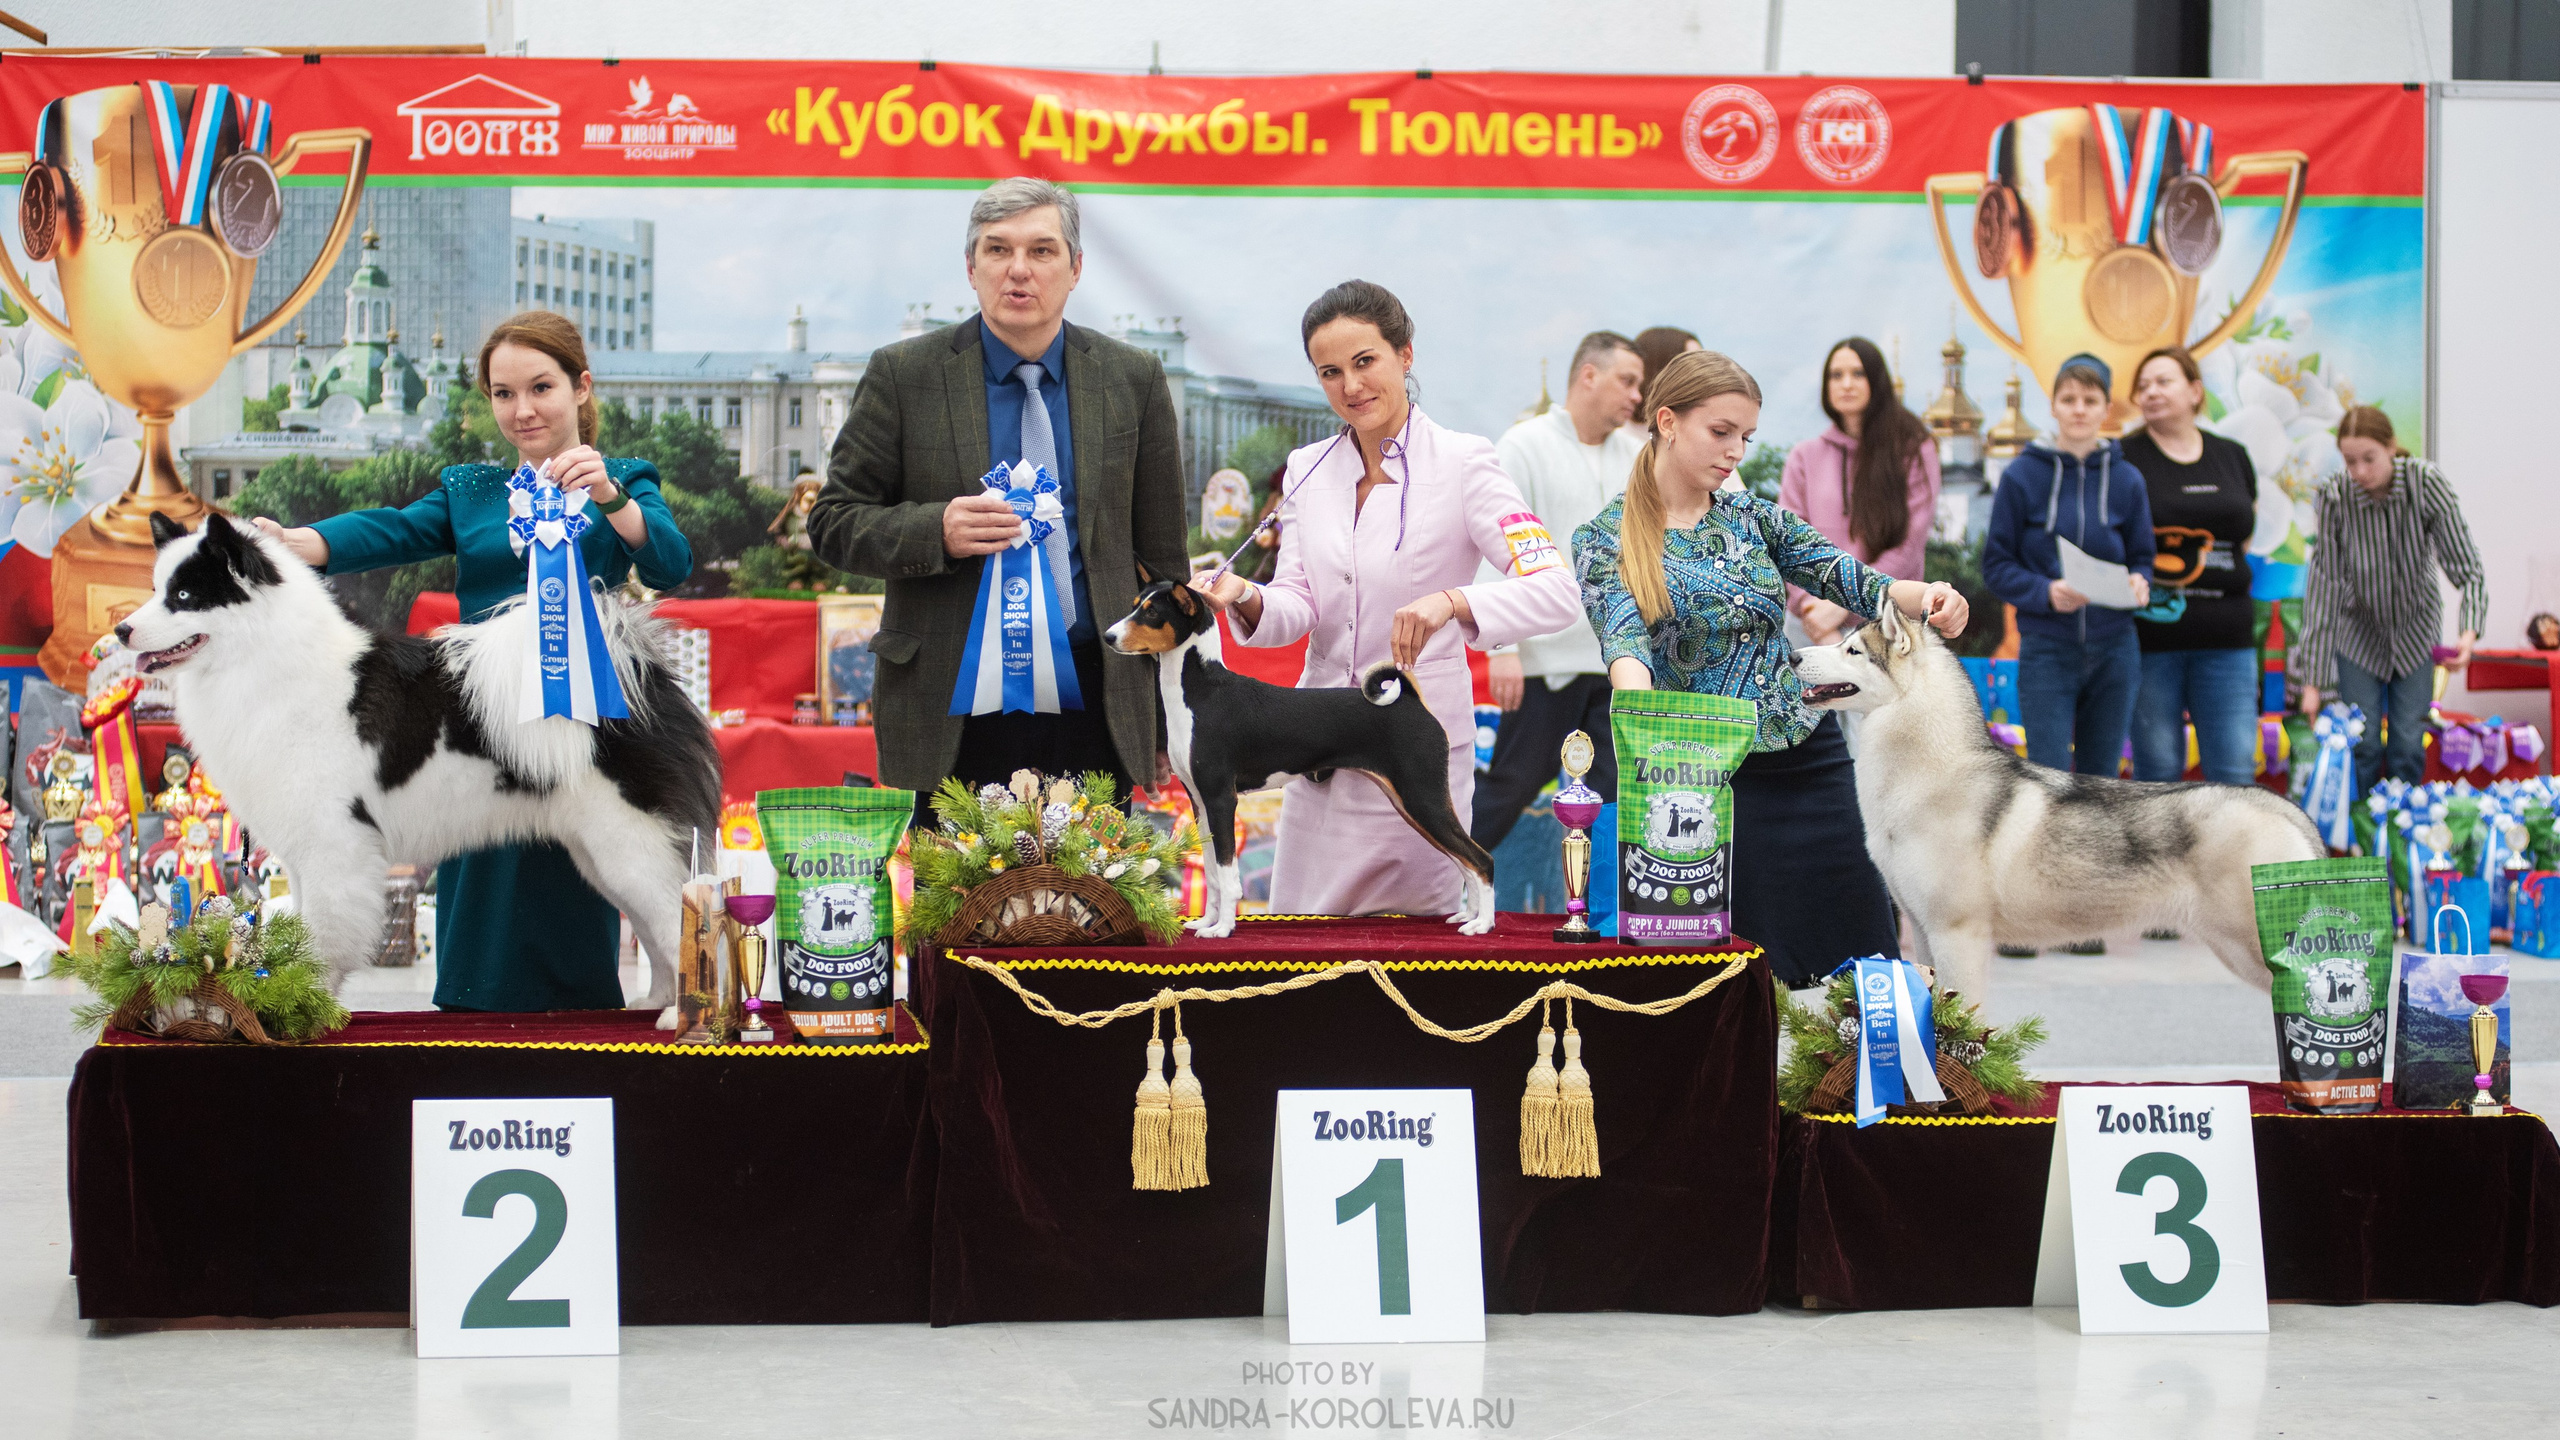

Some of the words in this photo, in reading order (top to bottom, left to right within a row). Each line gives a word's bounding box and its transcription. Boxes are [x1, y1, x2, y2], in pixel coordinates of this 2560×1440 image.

[766, 84, 1004, 158] «Кубок
[1019, 97, 1327, 165] Дружбы.
[1350, 98, 1662, 157] Тюмень»
[584, 124, 612, 144] МИР
[621, 121, 666, 144] ЖИВОЙ
[673, 124, 736, 145] ПРИРОДЫ
[1822, 121, 1866, 143] FCI
[624, 148, 695, 160] ЗООЦЕНТР
[544, 604, 562, 612] DOG
[1003, 611, 1029, 619] SHOW
[541, 614, 566, 622] SHOW
[545, 631, 563, 640] Best
[1007, 628, 1026, 637] Best
[549, 643, 559, 652] In
[1012, 640, 1022, 648] In
[540, 654, 568, 665] Group
[1002, 651, 1032, 661] Group
[1650, 741, 1678, 756] SUPER
[1681, 740, 1722, 760] PREMIUM
[1634, 757, 1733, 792] ZooRing
[1680, 807, 1702, 815] ZooRing
[800, 831, 829, 849] SUPER
[833, 831, 874, 850] PREMIUM
[785, 852, 886, 883] ZooRing
[1649, 862, 1677, 879] DOG
[1680, 863, 1712, 879] FOOD
[833, 899, 855, 907] ZooRing
[2297, 907, 2323, 927] SUPER
[2323, 905, 2361, 925] PREMIUM
[1628, 917, 1653, 930] PUPPY
[1656, 919, 1662, 930] &
[1666, 919, 1700, 930] JUNIOR
[1702, 919, 1708, 930] 2
[2284, 927, 2377, 957] ZooRing
[805, 957, 834, 973] DOG
[837, 956, 872, 974] FOOD
[1870, 994, 1889, 1002] DOG
[1866, 1002, 1893, 1011] SHOW
[821, 1013, 852, 1026] ADULT
[855, 1012, 874, 1026] DOG
[1871, 1019, 1891, 1028] Best
[1877, 1031, 1887, 1039] In
[2314, 1029, 2340, 1043] DOG
[2343, 1027, 2369, 1043] FOOD
[1868, 1041, 1899, 1051] Group
[2330, 1085, 2358, 1099] ACTIVE
[2360, 1084, 2376, 1098] DOG
[1313, 1110, 1434, 1148] ZooRing
[2097, 1104, 2214, 1141] ZooRing
[448, 1119, 572, 1158] ZooRing
[1335, 1158, 1411, 1315] 1
[2115, 1151, 2220, 1308] 3
[460, 1168, 570, 1329] 2
